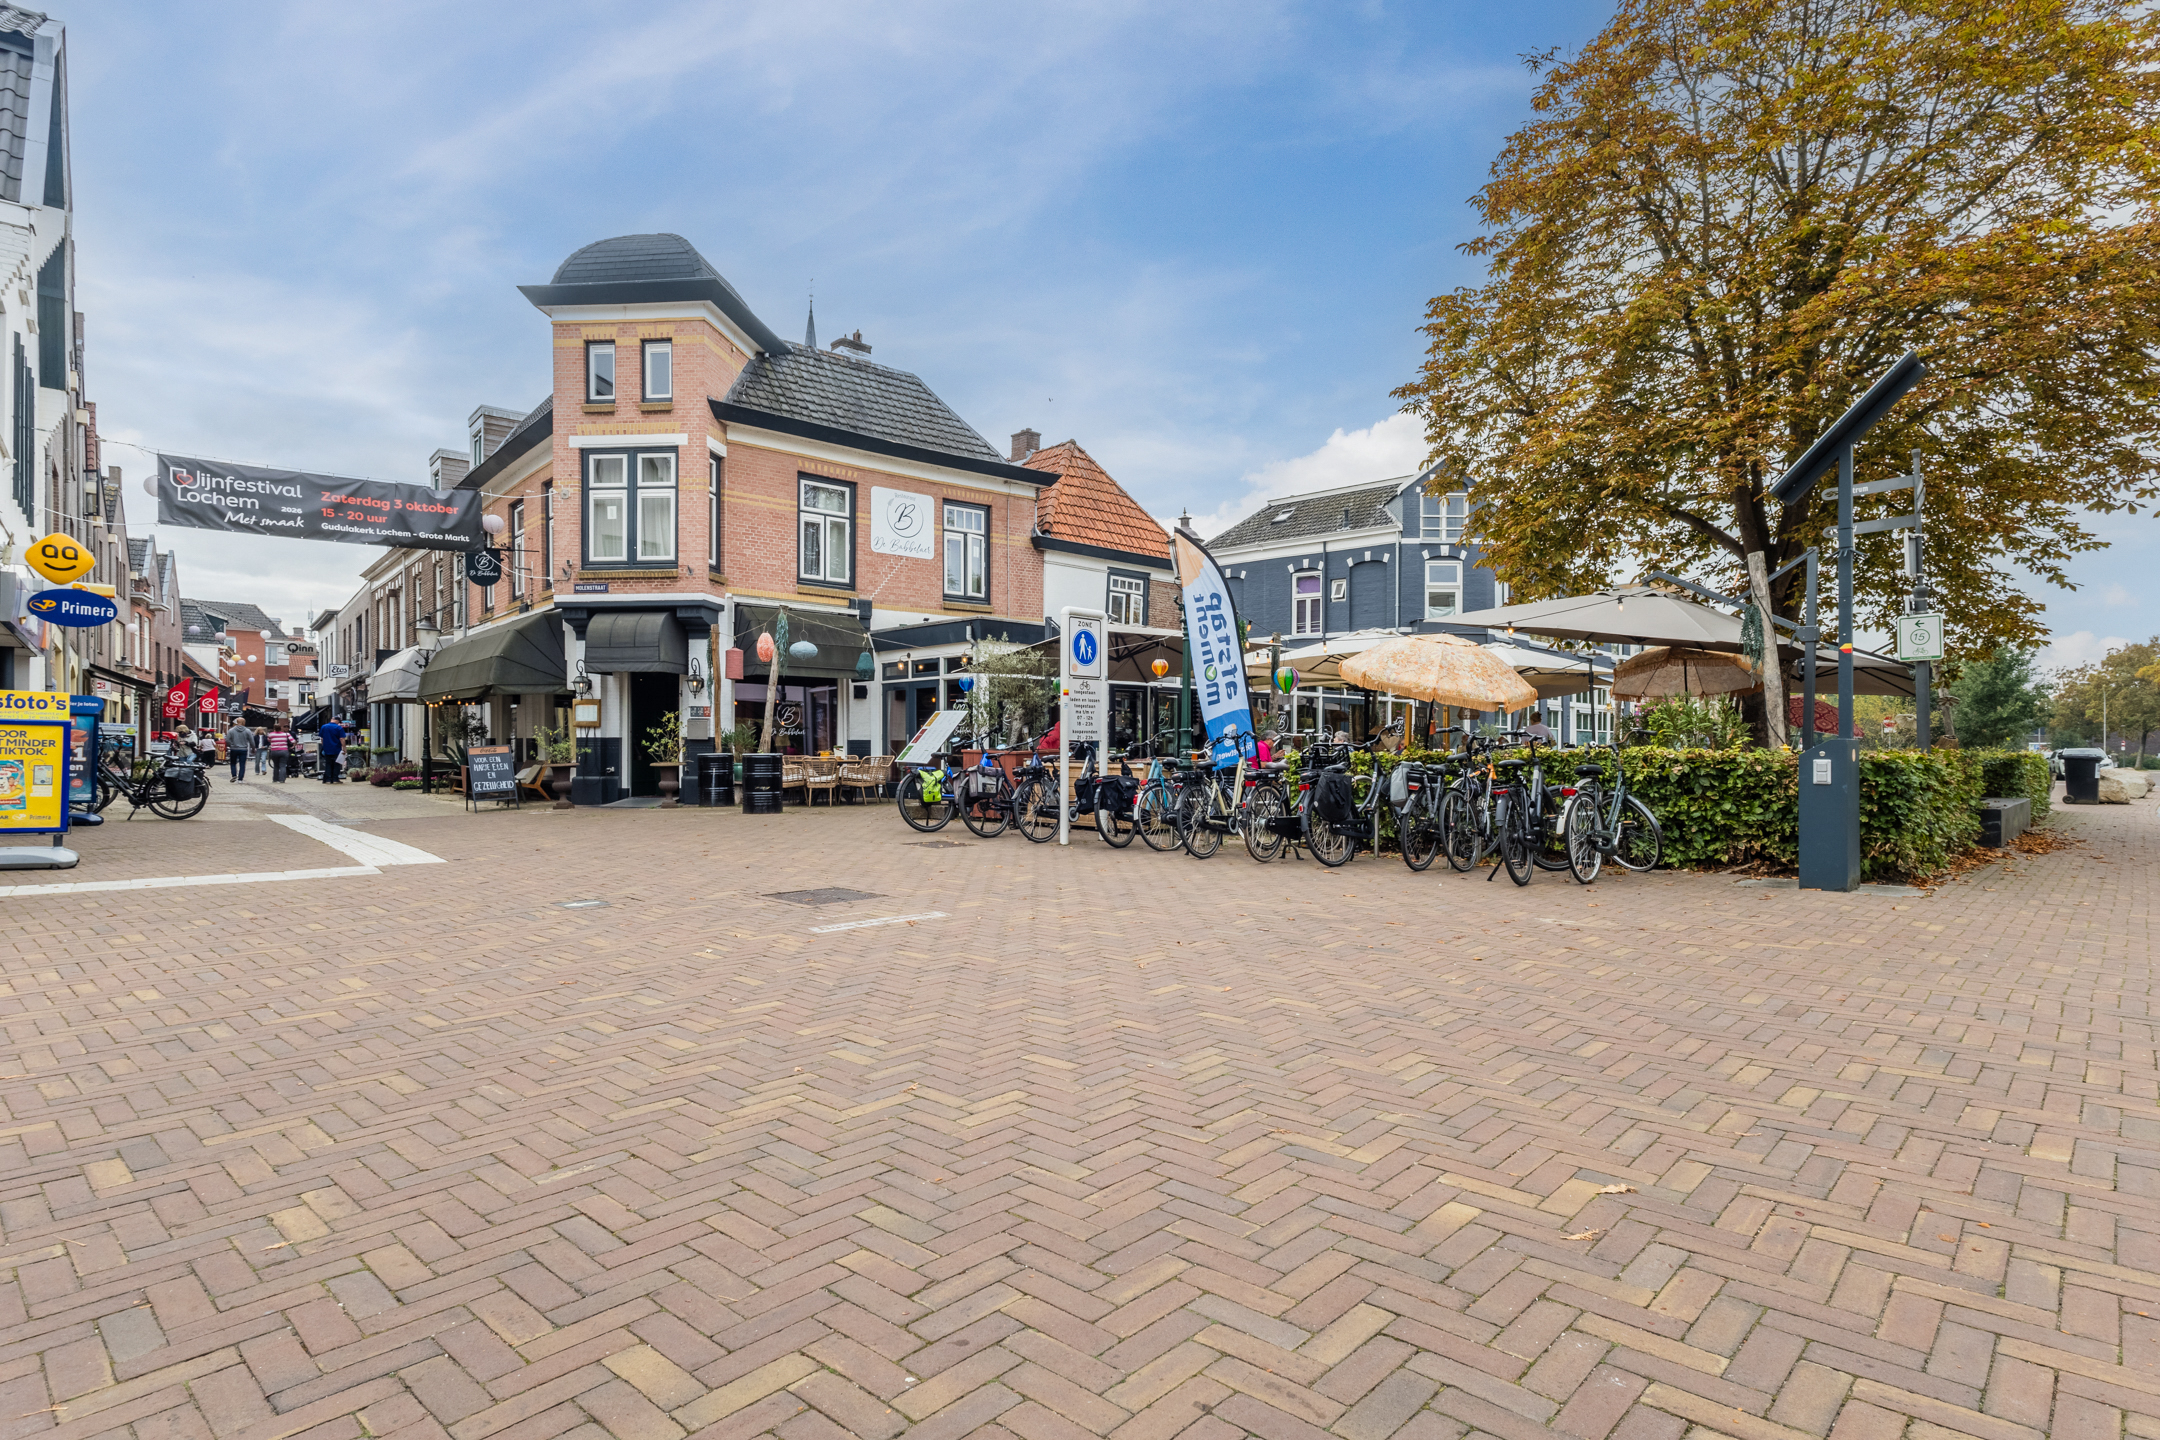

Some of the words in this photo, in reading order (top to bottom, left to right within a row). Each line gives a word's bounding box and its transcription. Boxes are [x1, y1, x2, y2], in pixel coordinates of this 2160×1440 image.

[1853, 486, 1868, 494] trum
[177, 487, 260, 510] Lochem
[321, 491, 390, 511] Zaterdag
[394, 499, 403, 509] 3
[406, 501, 460, 515] oktober
[224, 511, 258, 525] Met
[260, 516, 304, 528] smaak
[321, 508, 335, 518] 15
[347, 510, 364, 521] 20
[367, 514, 388, 524] uur
[894, 502, 916, 530] B
[321, 522, 375, 535] Gudulakerk
[376, 528, 412, 538] Lochem
[418, 531, 444, 540] Grote
[444, 534, 470, 542] Markt
[873, 536, 886, 550] De
[62, 600, 115, 618] Primera
[1078, 620, 1092, 628] ZONE
[1914, 632, 1926, 641] 15
[287, 642, 314, 654] Qinn
[332, 666, 348, 674] Etos
[6, 739, 56, 747] MINDER
